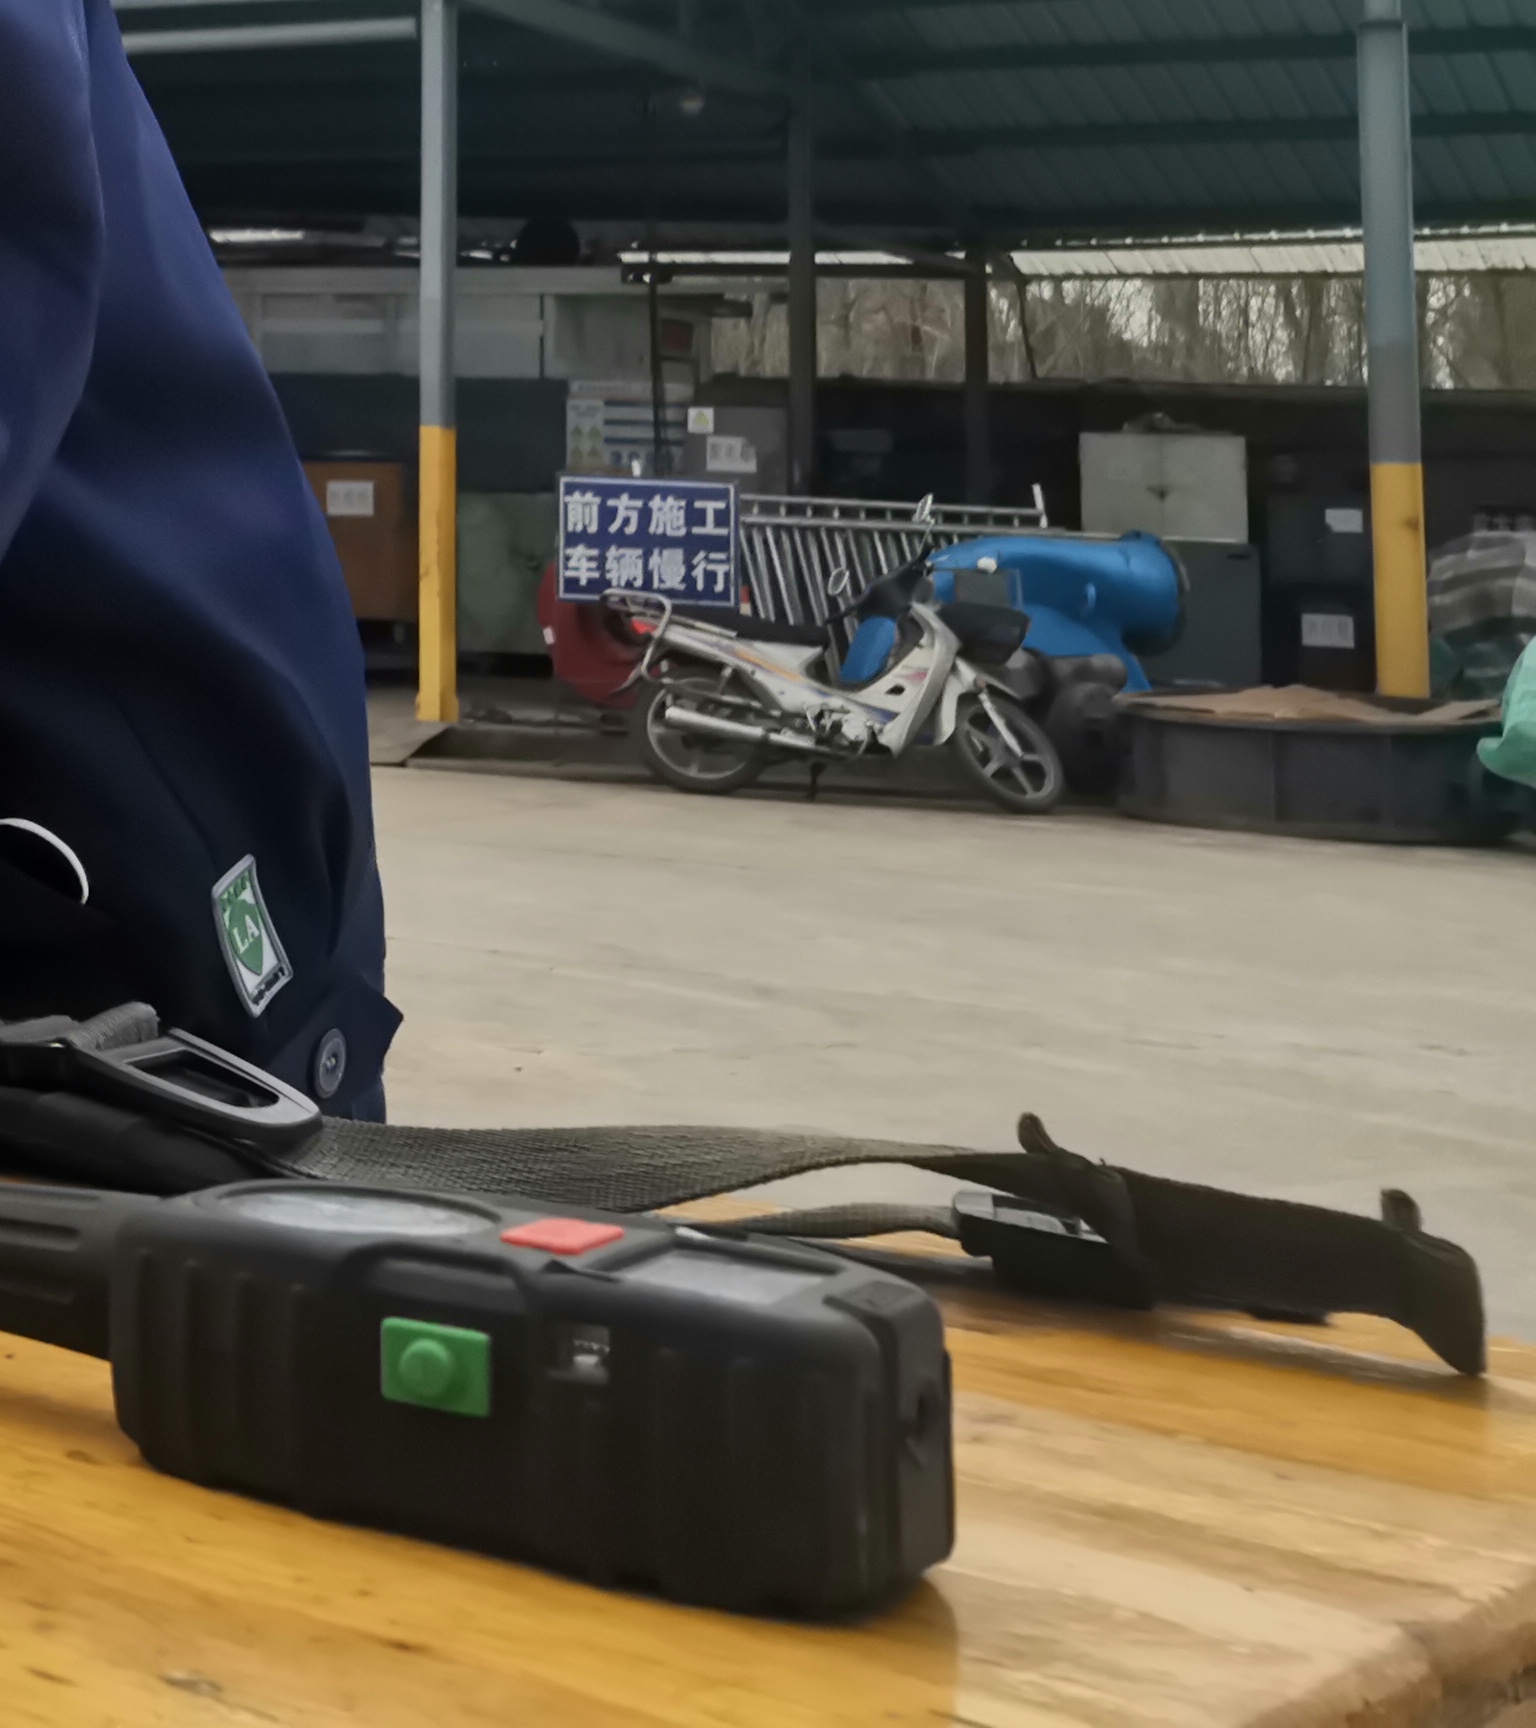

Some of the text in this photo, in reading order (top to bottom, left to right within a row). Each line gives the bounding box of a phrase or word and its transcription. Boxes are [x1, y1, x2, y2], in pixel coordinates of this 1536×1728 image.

[564, 490, 730, 538] 前方施工
[563, 543, 731, 594] 车辆慢行
[232, 913, 260, 955] LA
